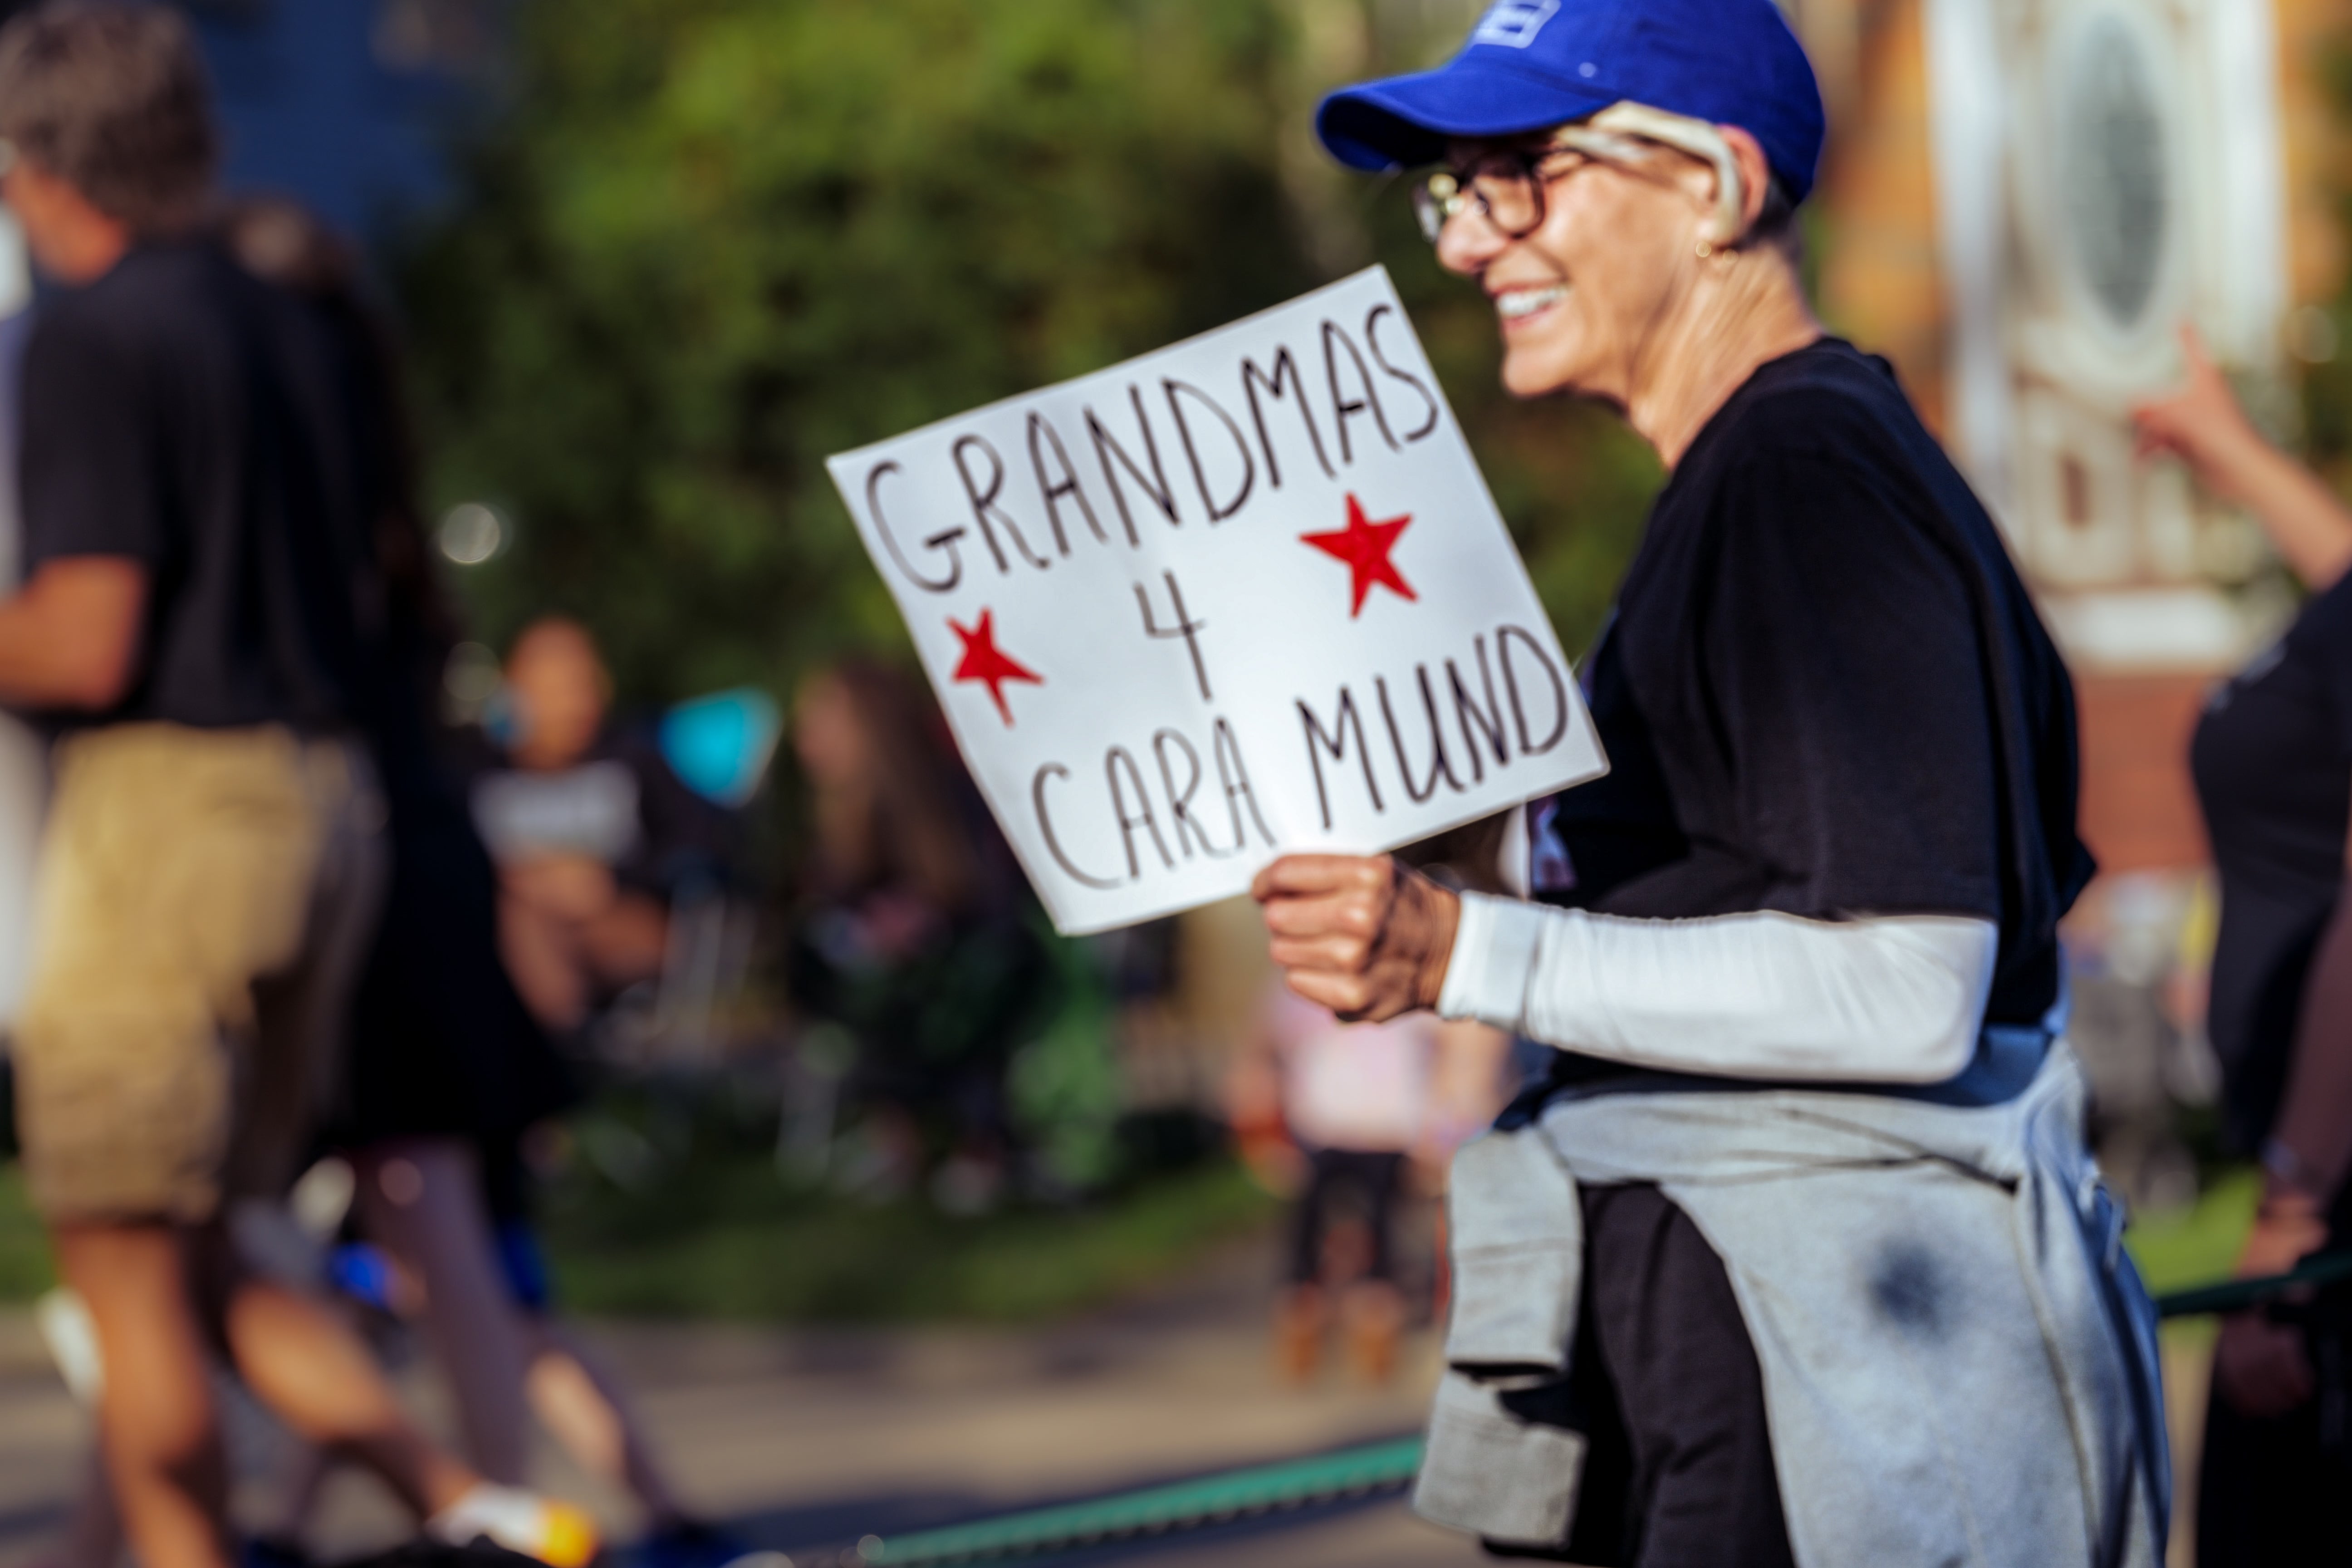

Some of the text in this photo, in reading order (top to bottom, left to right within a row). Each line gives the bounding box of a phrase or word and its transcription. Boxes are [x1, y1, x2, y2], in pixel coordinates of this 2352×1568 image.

[864, 303, 1440, 595] GRANDMAS
[1031, 624, 1569, 890] CARA MUND
[1132, 570, 1208, 702] 4
